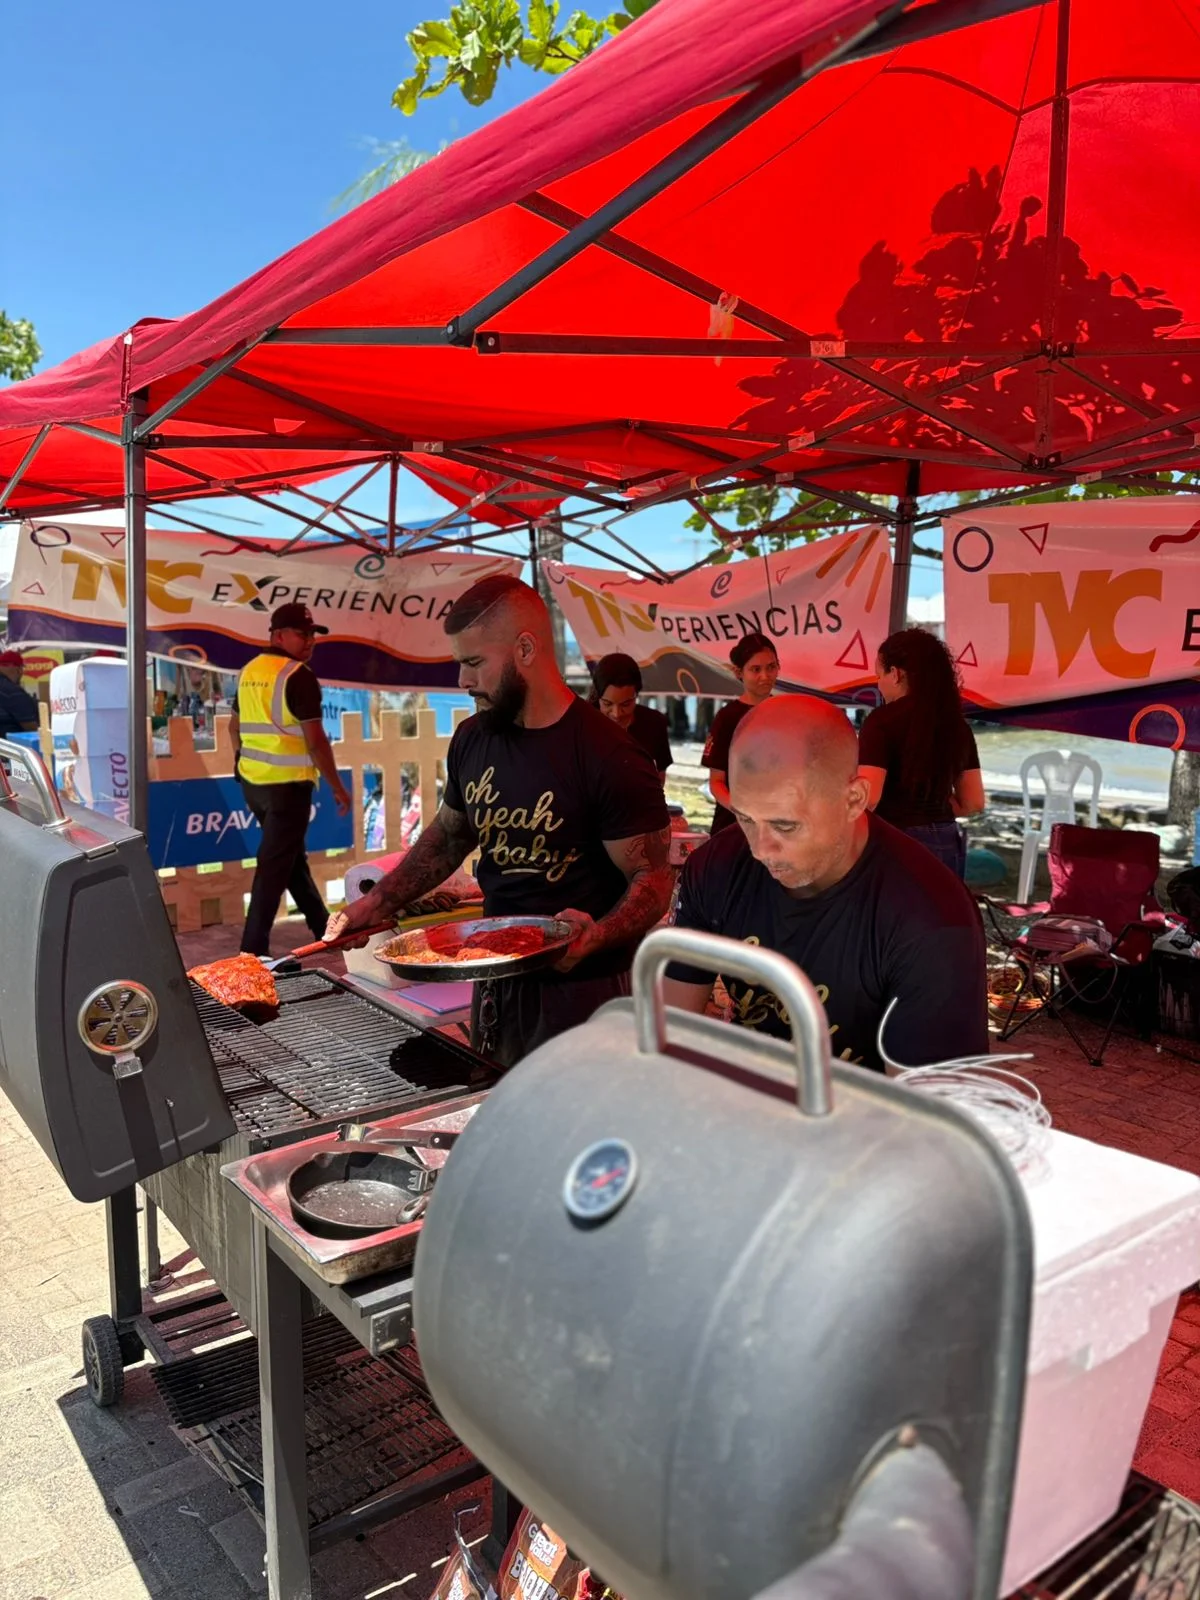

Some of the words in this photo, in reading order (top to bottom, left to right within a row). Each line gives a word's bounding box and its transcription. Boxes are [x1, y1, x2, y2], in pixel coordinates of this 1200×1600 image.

[211, 573, 454, 620] EXPERIENCIA
[648, 600, 842, 643] PERIENCIAS
[988, 568, 1163, 680] TVC
[109, 752, 130, 826] AVECTO
[465, 766, 500, 804] oh
[474, 791, 564, 848] yeah
[488, 831, 583, 882] baby
[528, 1523, 560, 1559] Great
[529, 1541, 552, 1567] Value
